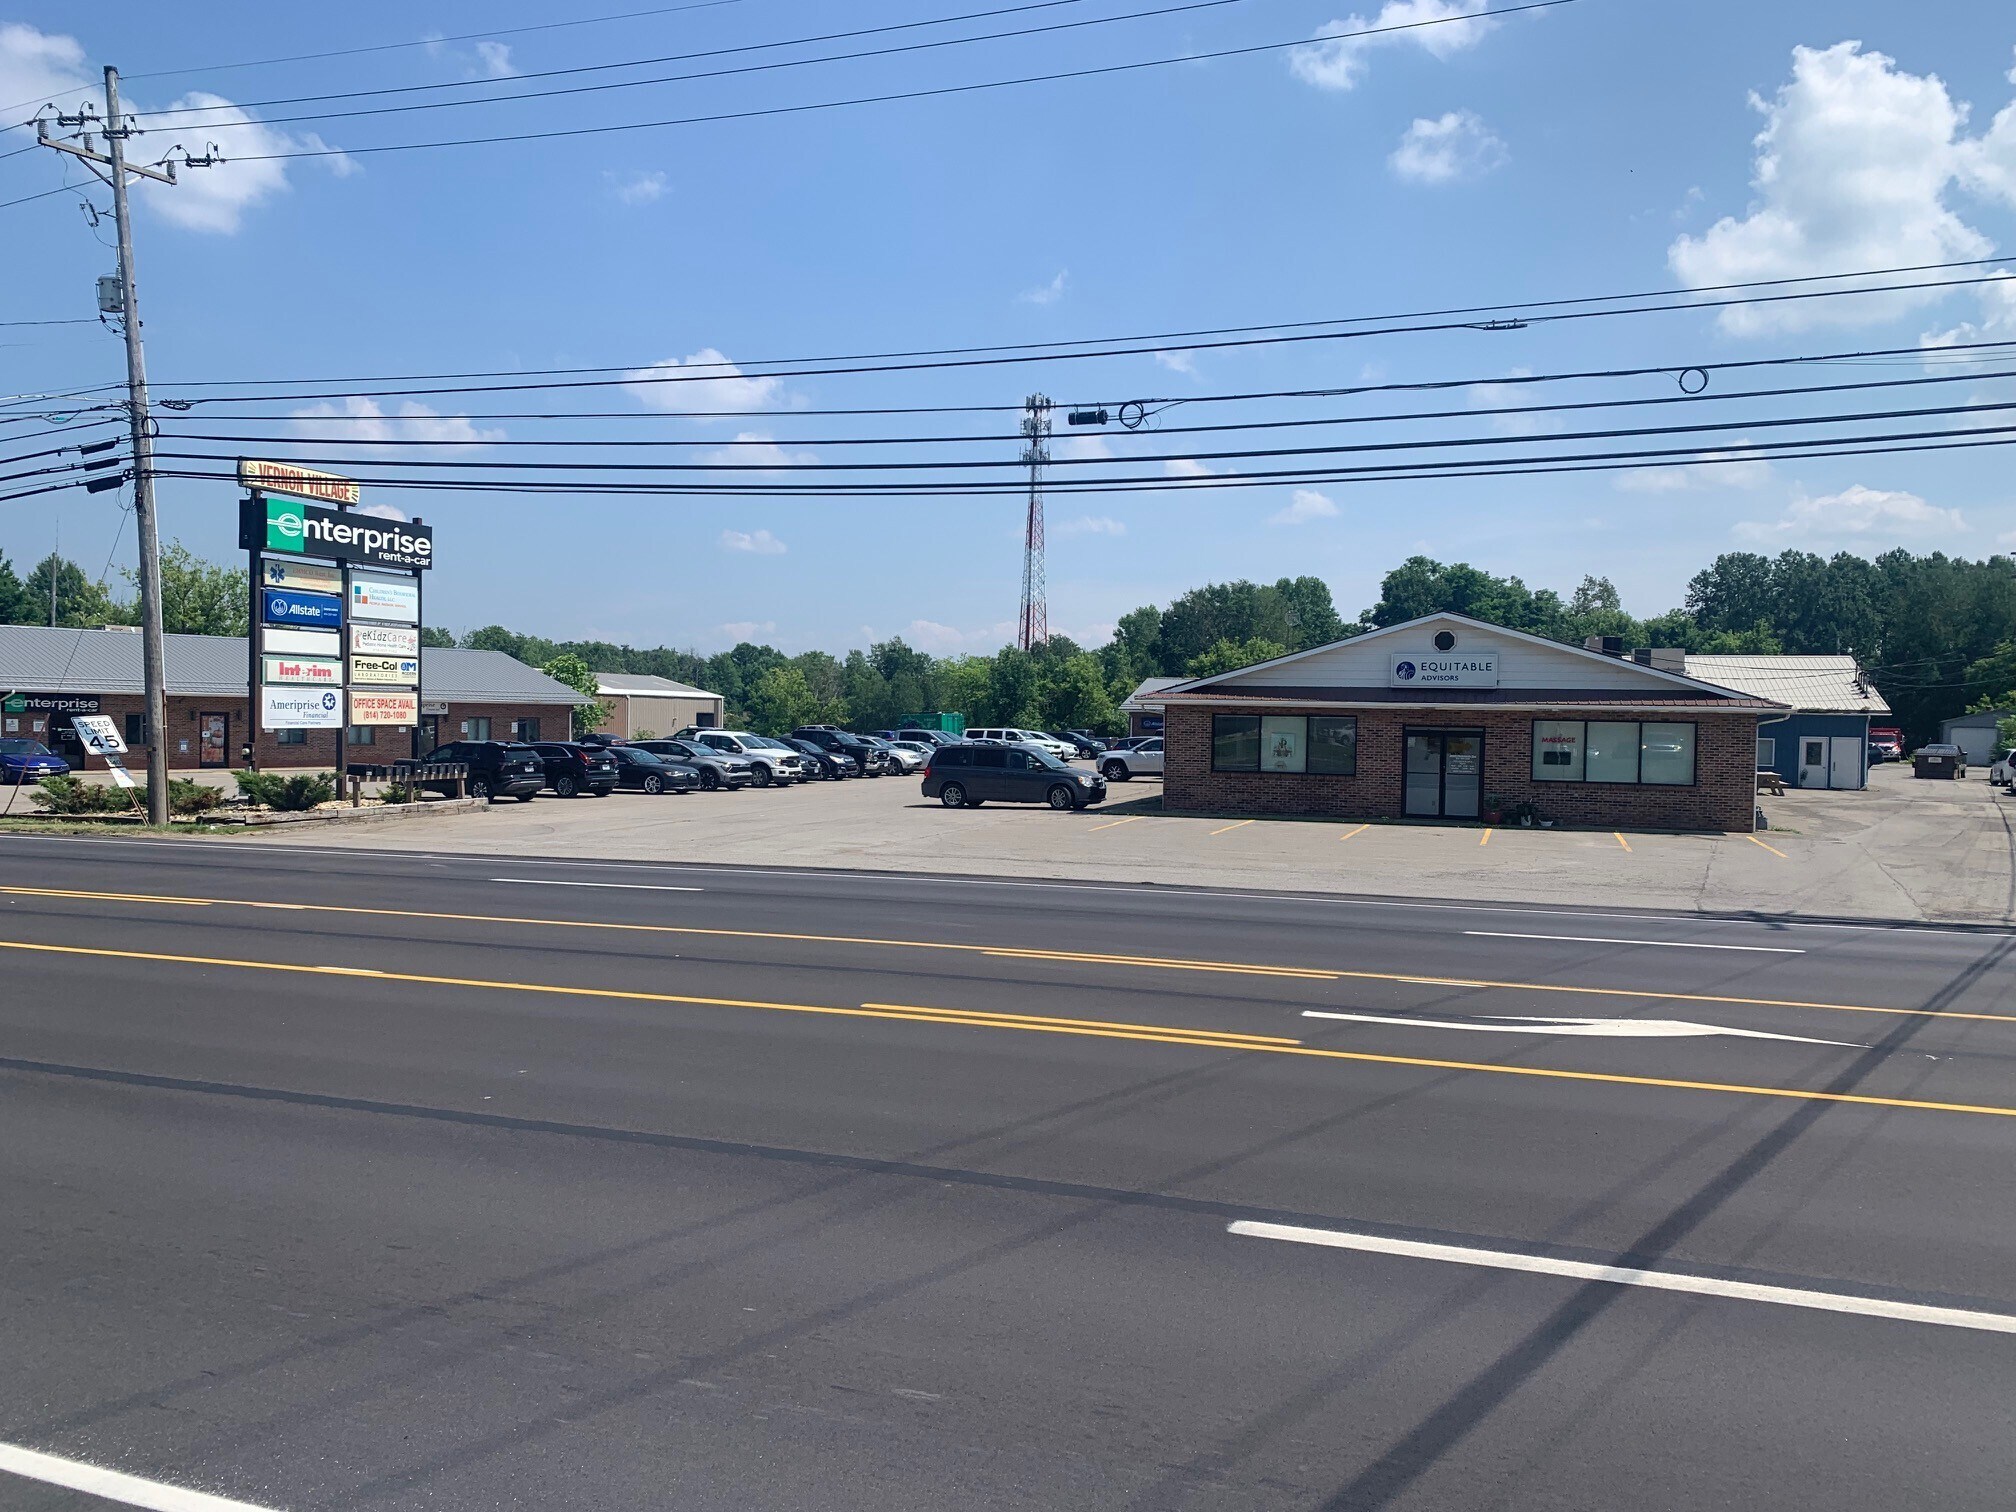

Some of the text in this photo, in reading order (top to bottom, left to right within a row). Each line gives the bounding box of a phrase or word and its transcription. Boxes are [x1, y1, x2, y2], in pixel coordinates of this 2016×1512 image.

[258, 463, 350, 501] VERNON VILLAGE
[277, 512, 432, 556] enterprise
[378, 550, 431, 567] rent-a-car
[288, 604, 321, 617] Allstate
[362, 630, 407, 643] eKidzCare
[354, 659, 398, 671] Free-Col
[1420, 662, 1493, 673] EQUITABLE
[11, 698, 99, 710] enterprise
[269, 699, 320, 713] Ameriprise
[353, 698, 416, 710] OFFICE SPACE AVAIL.
[302, 711, 329, 719] Financial
[363, 711, 379, 720] (814)
[77, 720, 111, 728] SPEED
[89, 735, 120, 749] 45
[1541, 736, 1577, 744] MASSAGE
